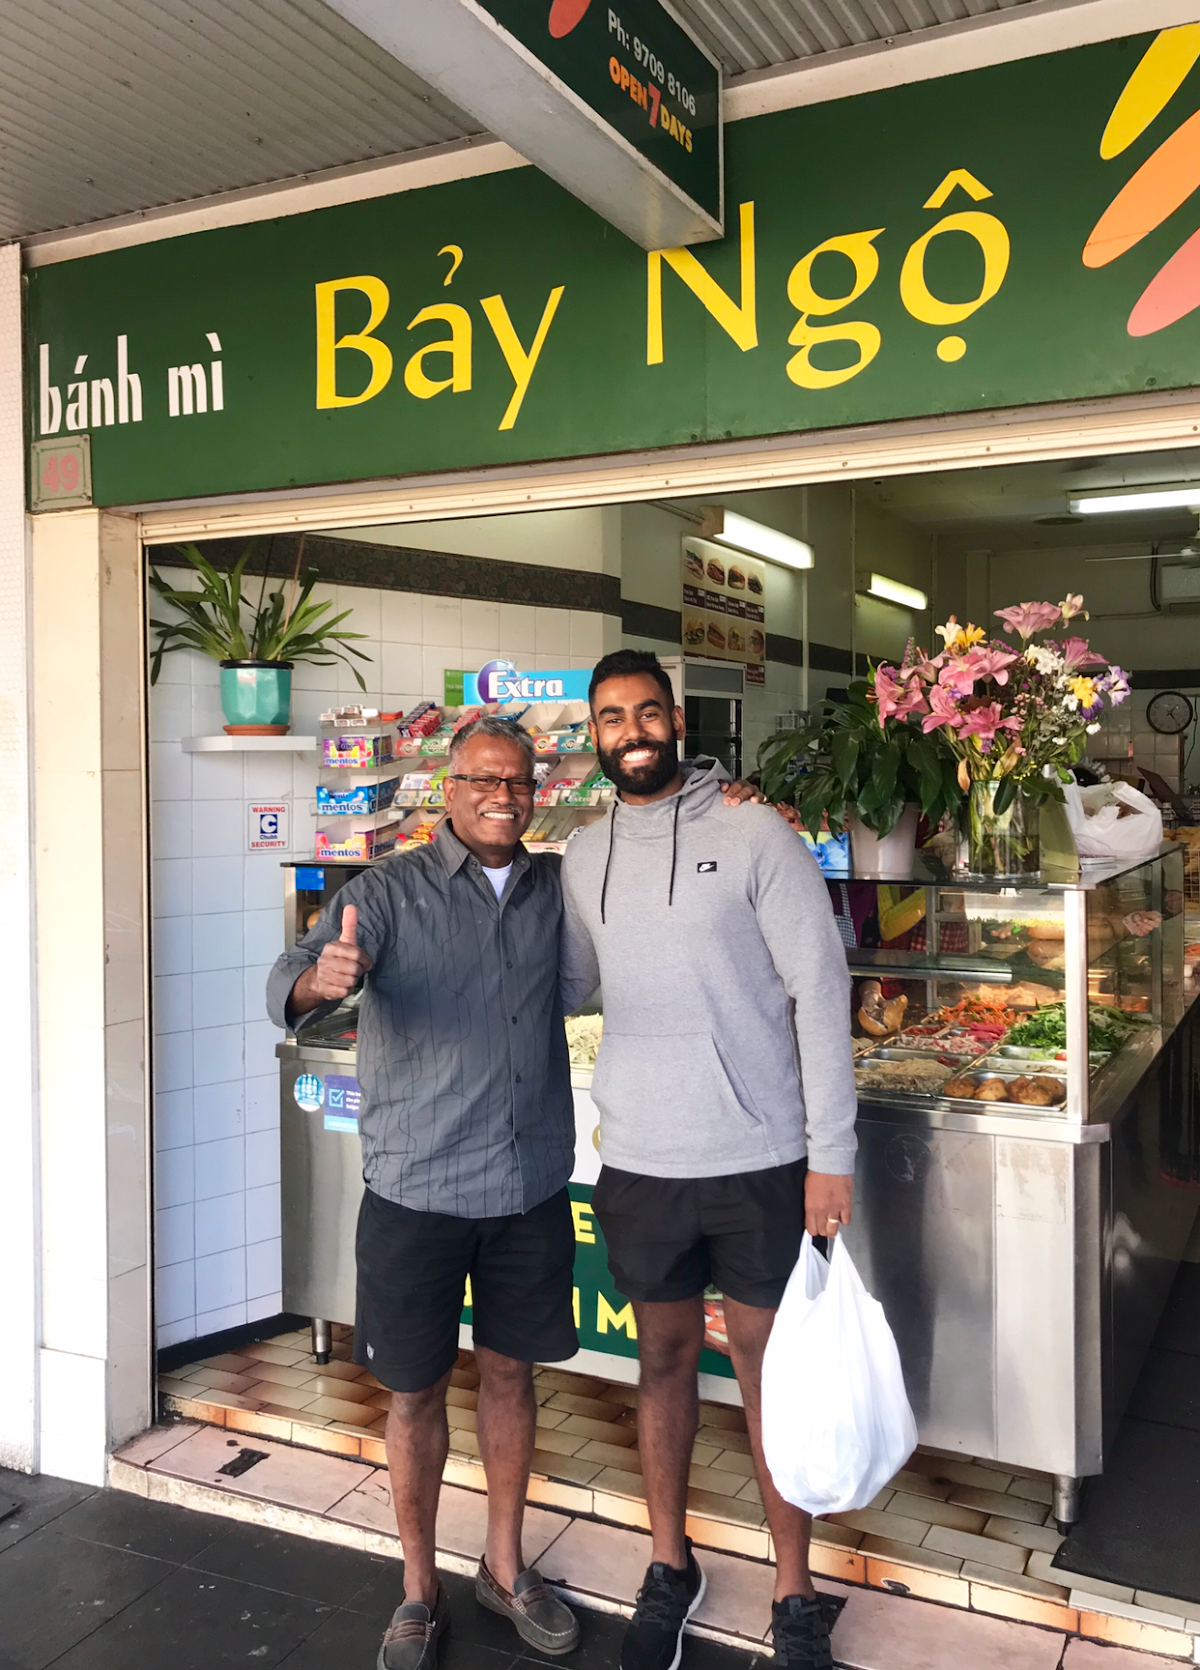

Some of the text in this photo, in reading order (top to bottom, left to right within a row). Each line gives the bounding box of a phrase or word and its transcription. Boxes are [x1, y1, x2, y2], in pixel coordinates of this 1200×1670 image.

[608, 8, 696, 116] Ph: 9709 8106
[609, 56, 692, 153] OPEN 7 DAYS
[315, 168, 1010, 431] Bảy Ngộ
[39, 332, 224, 435] bánh mì
[42, 455, 78, 491] 49
[488, 671, 563, 699] Extra
[325, 757, 358, 765] mentos
[322, 803, 363, 812] mentos
[320, 848, 361, 857] mentos
